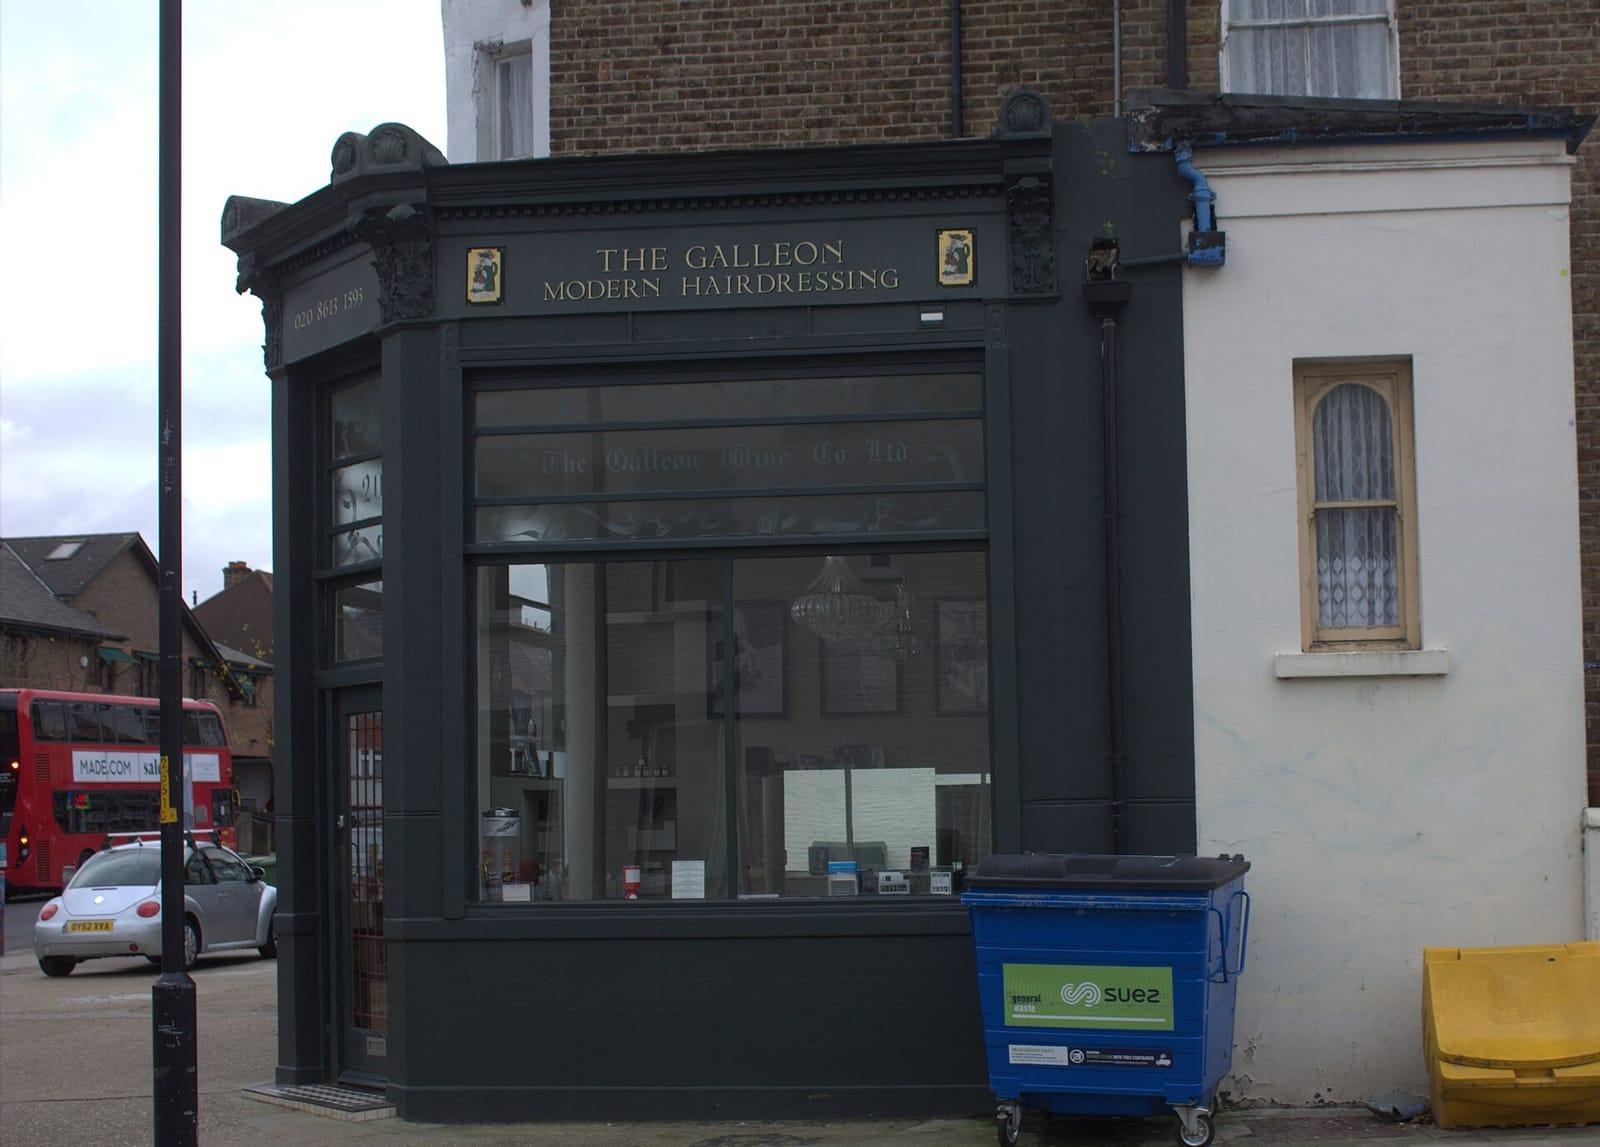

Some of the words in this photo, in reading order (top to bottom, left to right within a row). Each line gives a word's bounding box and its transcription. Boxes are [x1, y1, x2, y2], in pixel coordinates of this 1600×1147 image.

[596, 248, 669, 272] THE
[685, 240, 844, 269] GALLEON
[543, 278, 661, 301] MODERN
[681, 268, 900, 296] HAIRDRESSING
[294, 308, 313, 330] 020
[317, 297, 338, 320] 8613
[344, 287, 363, 310] 1593
[542, 450, 587, 474] The
[606, 447, 700, 473] Galleon
[80, 759, 132, 776] MADE.COM
[1012, 993, 1041, 1004] general
[1104, 987, 1160, 1004] suez
[1013, 1004, 1036, 1013] waste
